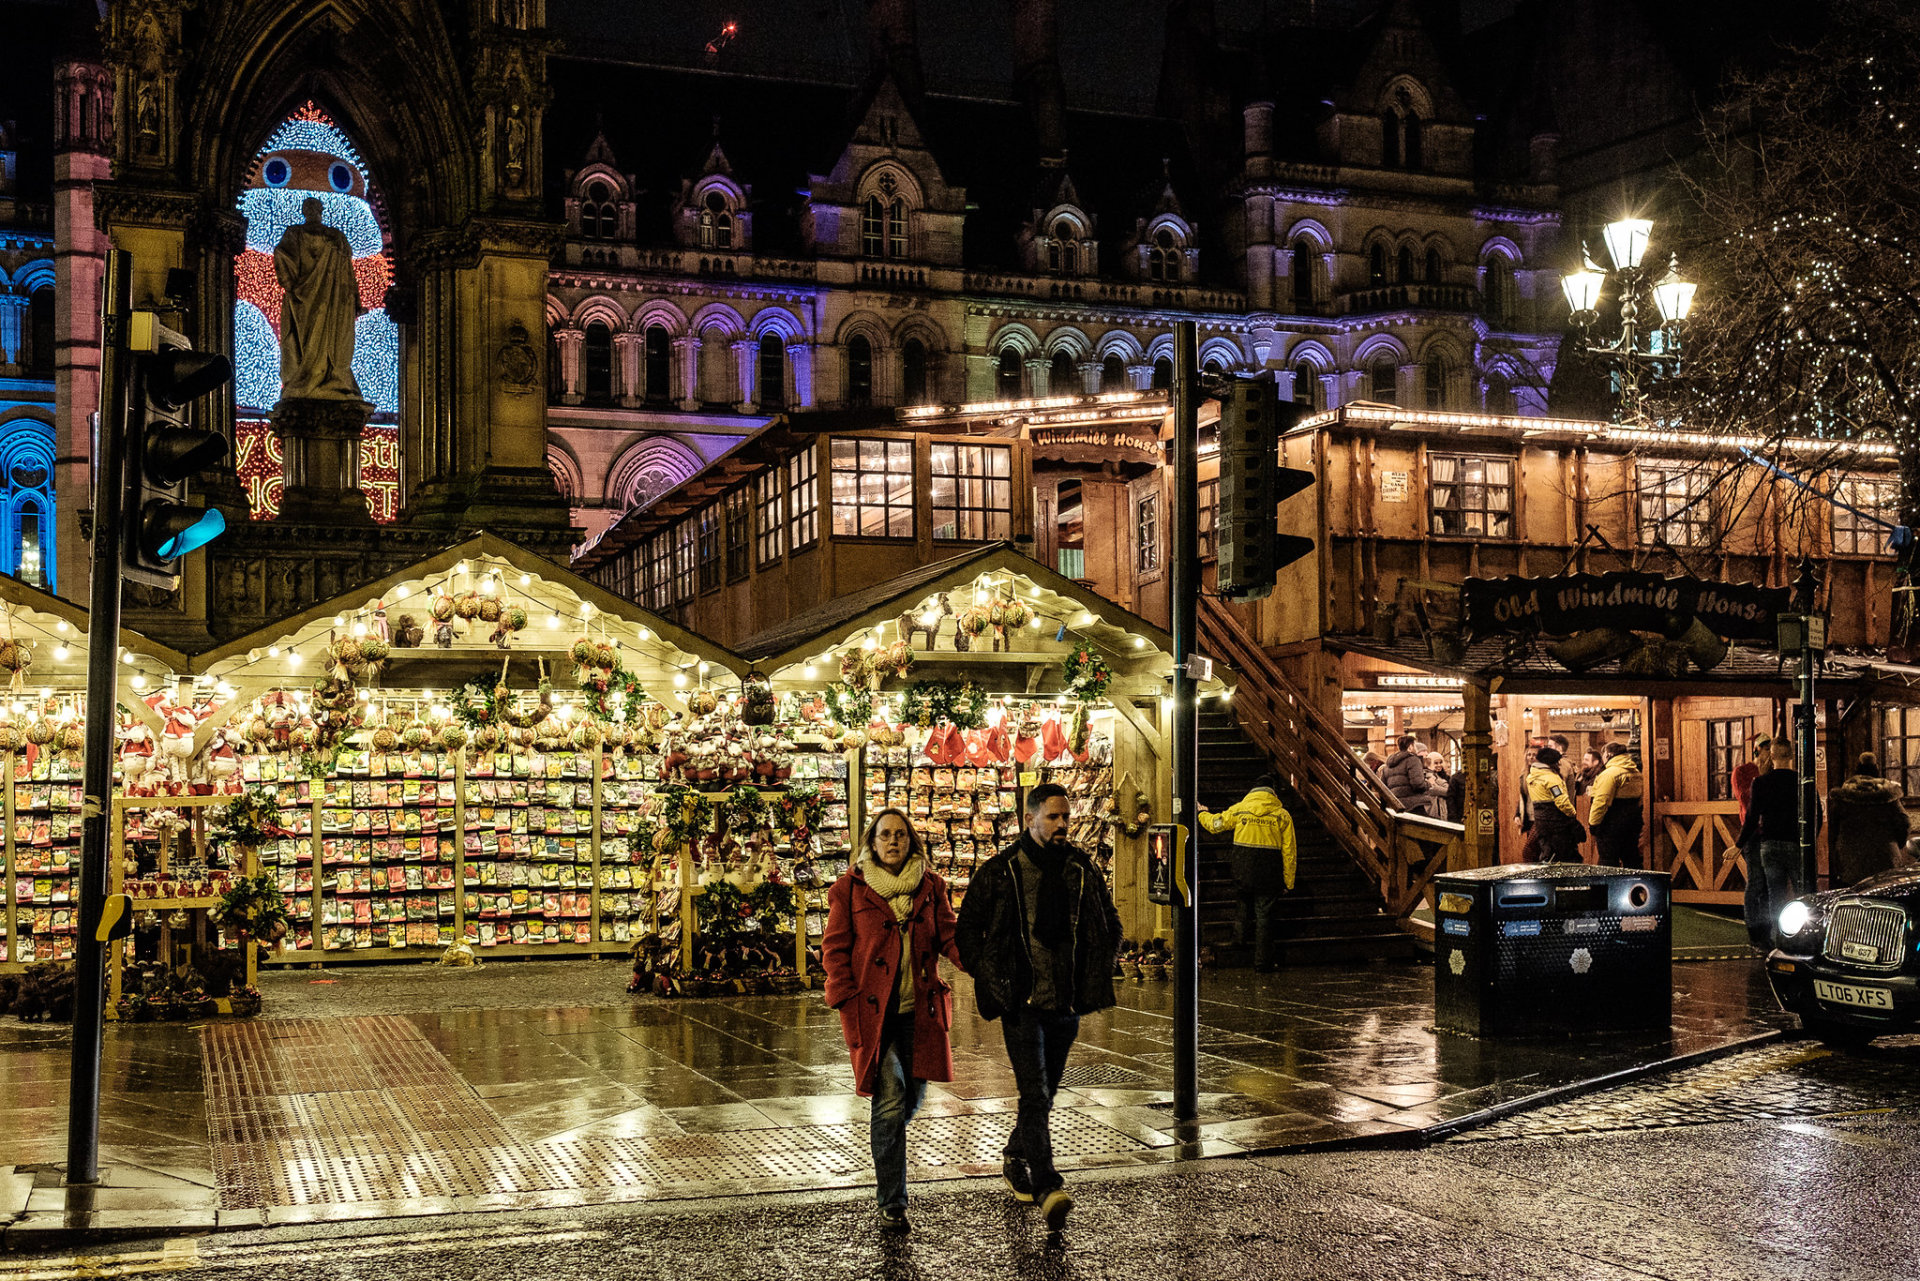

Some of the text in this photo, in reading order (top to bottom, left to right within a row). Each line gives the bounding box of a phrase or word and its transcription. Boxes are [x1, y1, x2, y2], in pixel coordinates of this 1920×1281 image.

[1037, 429, 1158, 454] Windmill House
[1494, 589, 1541, 622] Old
[1557, 582, 1679, 611] Windmill
[1818, 982, 1886, 1005] LT06 XFS
